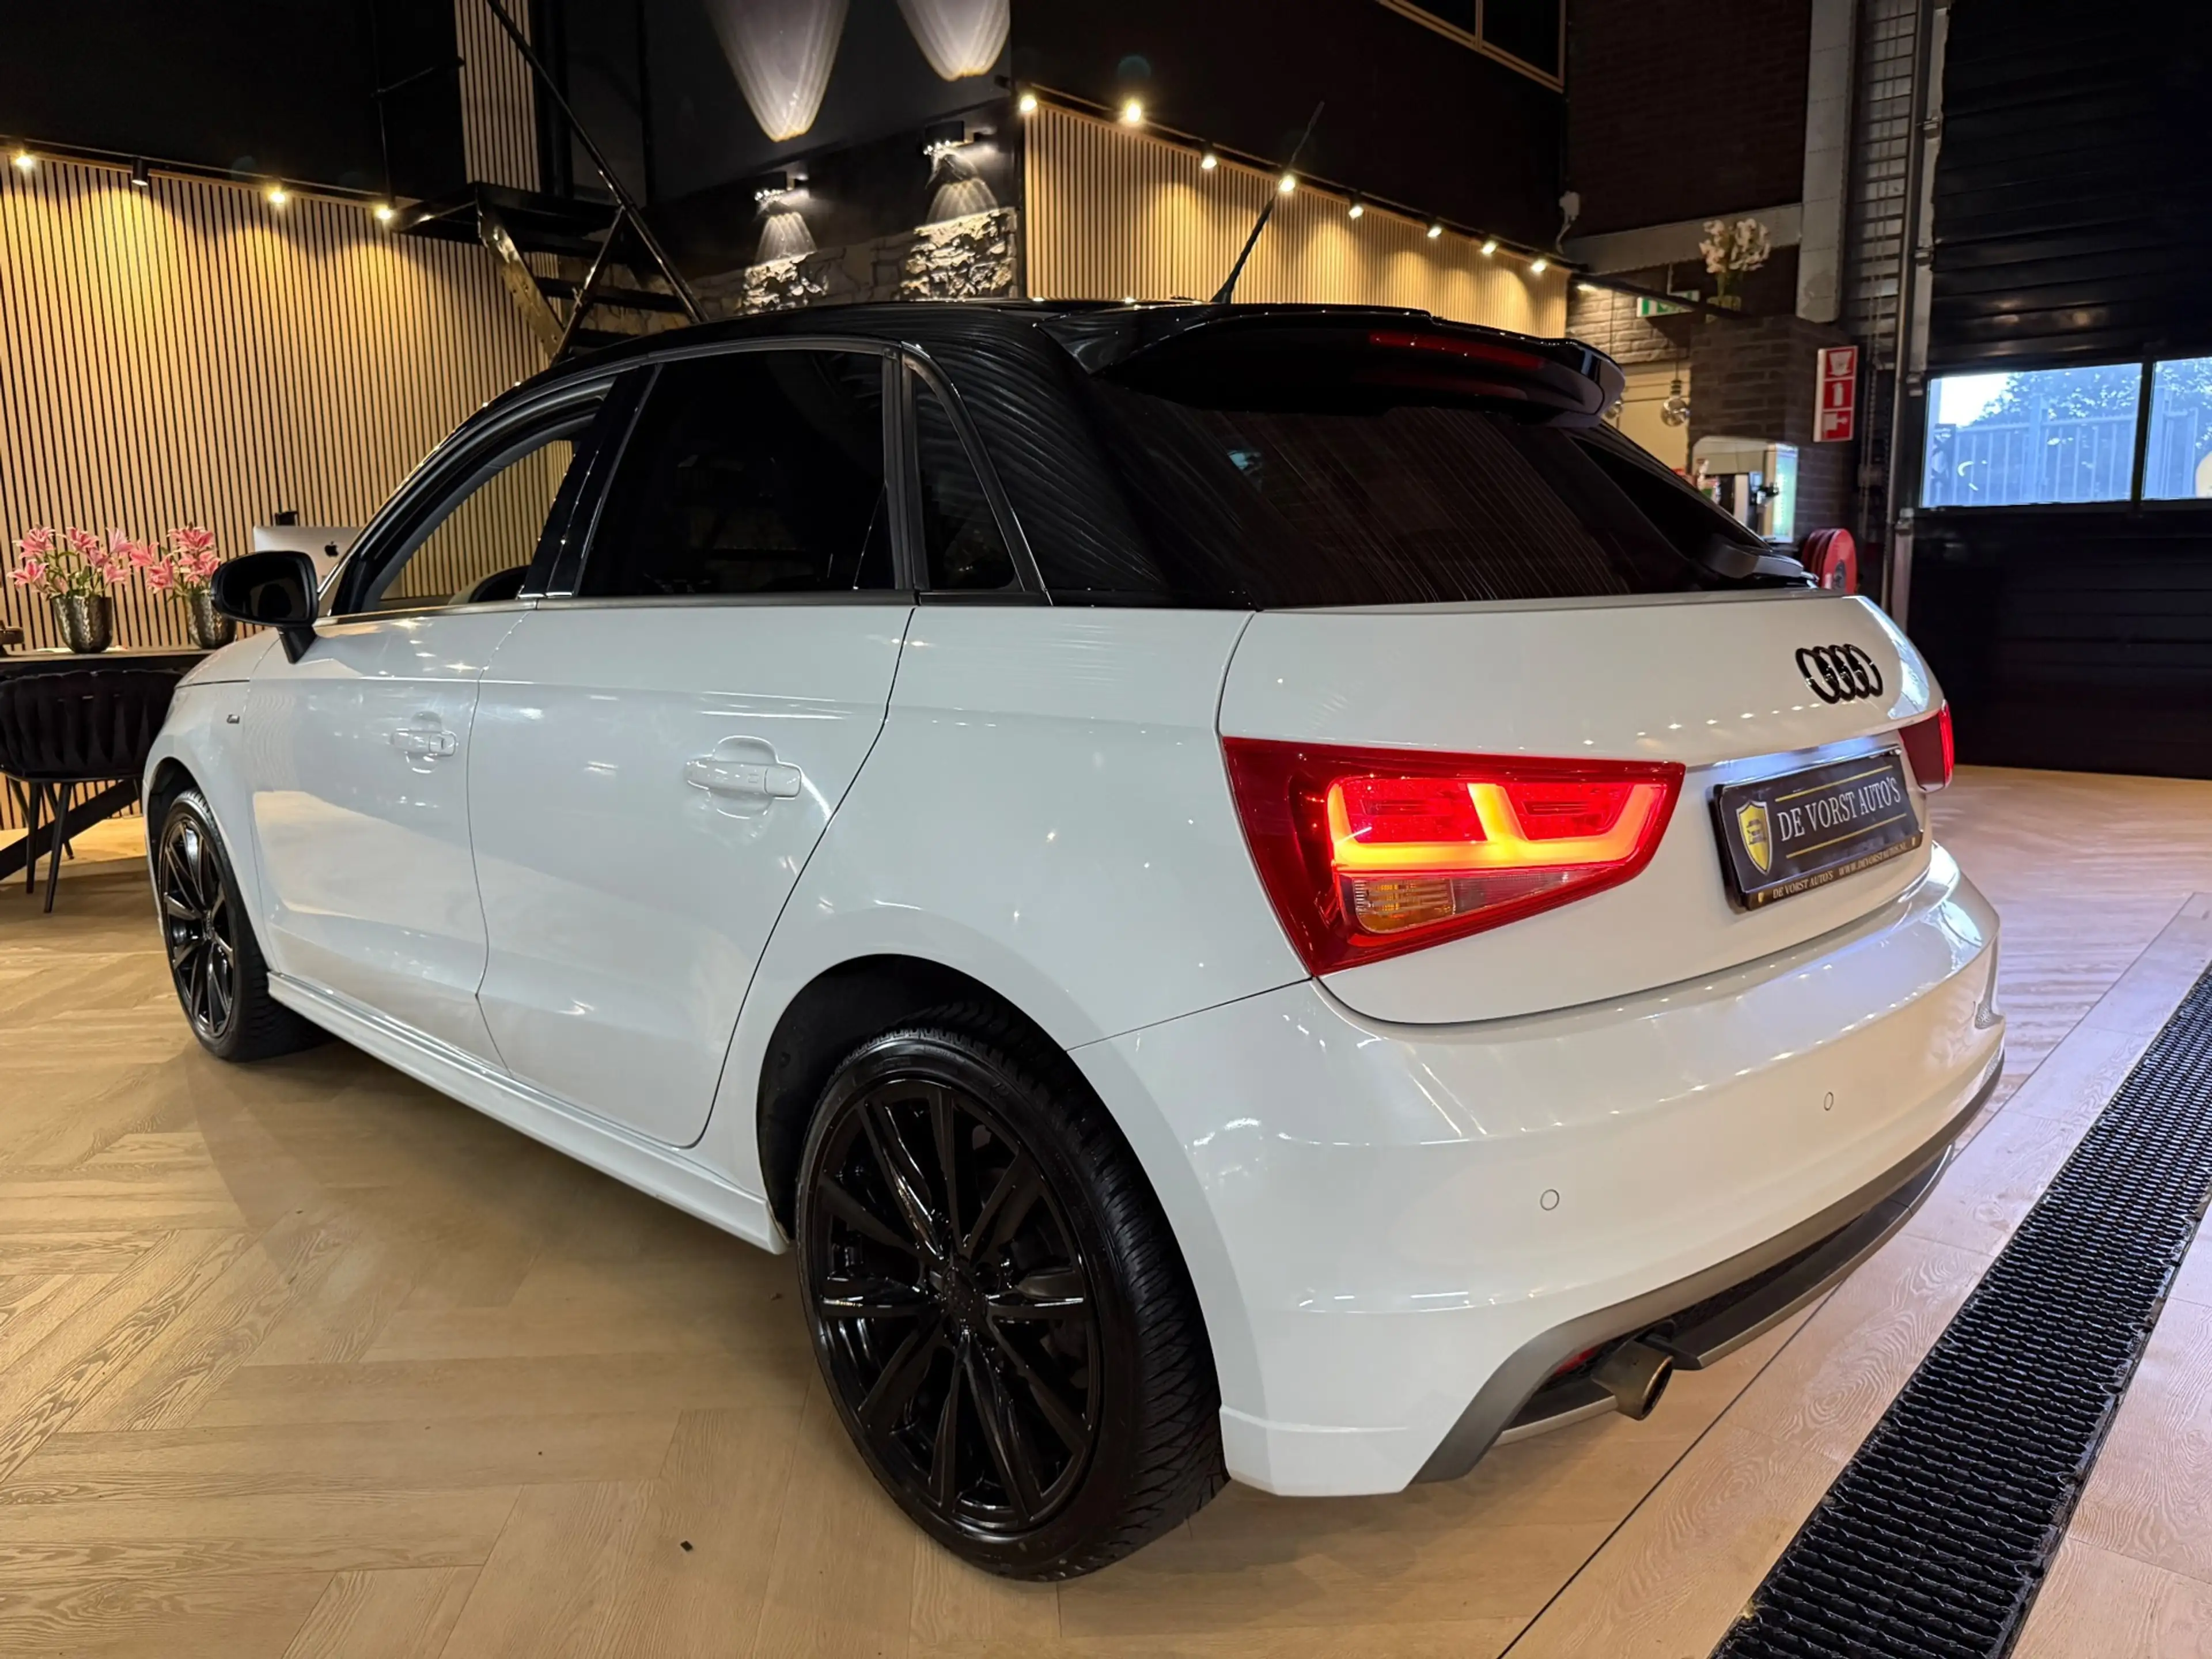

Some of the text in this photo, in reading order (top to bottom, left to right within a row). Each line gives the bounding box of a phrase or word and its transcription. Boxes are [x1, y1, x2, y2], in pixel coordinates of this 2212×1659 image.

[1777, 777, 1901, 842] DE VORST AUTO'S
[1772, 887, 1784, 899] DE
[1785, 878, 1809, 895] VORST
[1809, 870, 1834, 887] AUTO'S
